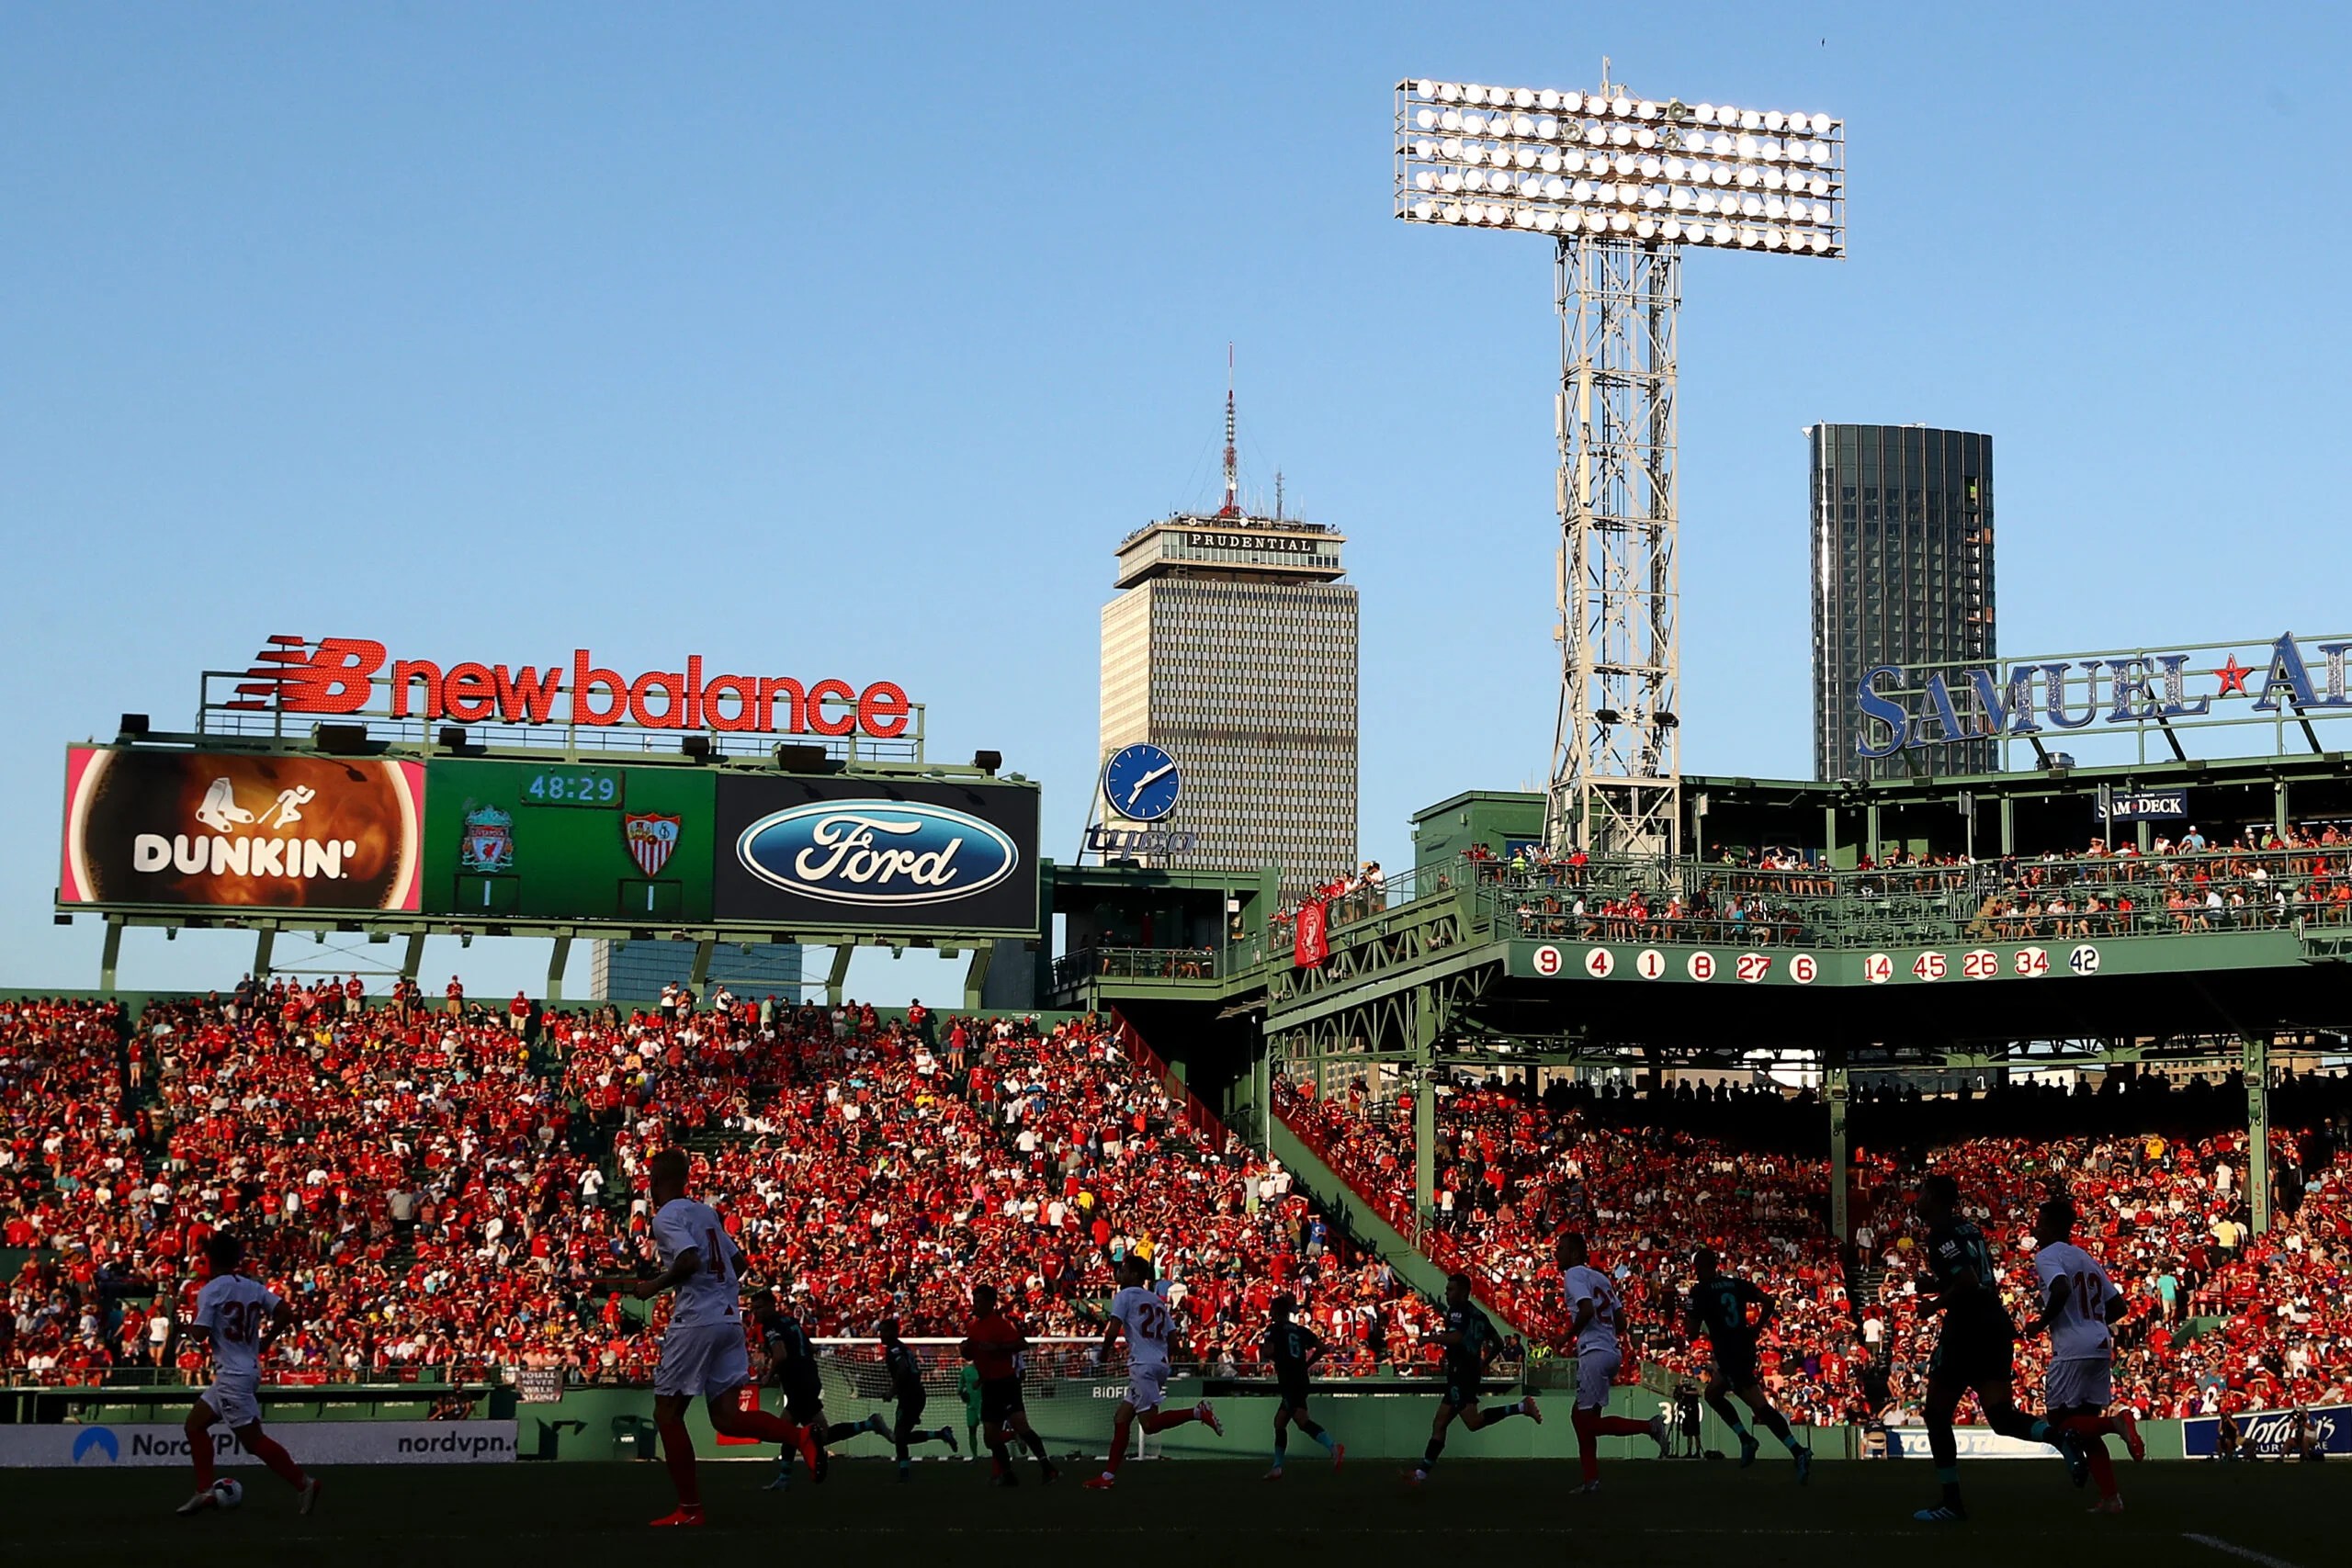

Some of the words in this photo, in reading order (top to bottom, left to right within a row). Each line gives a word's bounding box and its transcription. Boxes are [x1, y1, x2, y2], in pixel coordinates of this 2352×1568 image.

[1192, 534, 1312, 552] PRUDENTIAL
[1857, 653, 2209, 759] SAMUEL
[529, 775, 615, 800] 48:29
[2138, 798, 2183, 814] DECK
[795, 814, 963, 886] Ford
[1087, 823, 1195, 861] tyco
[1540, 950, 1557, 973] 9
[1591, 952, 1607, 974] 4
[1647, 954, 1657, 976] 1
[1694, 955, 1711, 978] 8
[1736, 956, 1771, 979] 27
[1796, 958, 1813, 980] 6
[1865, 957, 1891, 980] 14
[1913, 955, 1947, 977] 45
[1963, 953, 1997, 976] 26
[2015, 951, 2049, 974] 34
[2070, 949, 2097, 972] 42
[706, 1227, 726, 1282] 4
[1720, 1292, 1738, 1329] 3
[2073, 1271, 2104, 1321] 12
[1138, 1303, 1166, 1339] 22
[1287, 1332, 1301, 1359] 6
